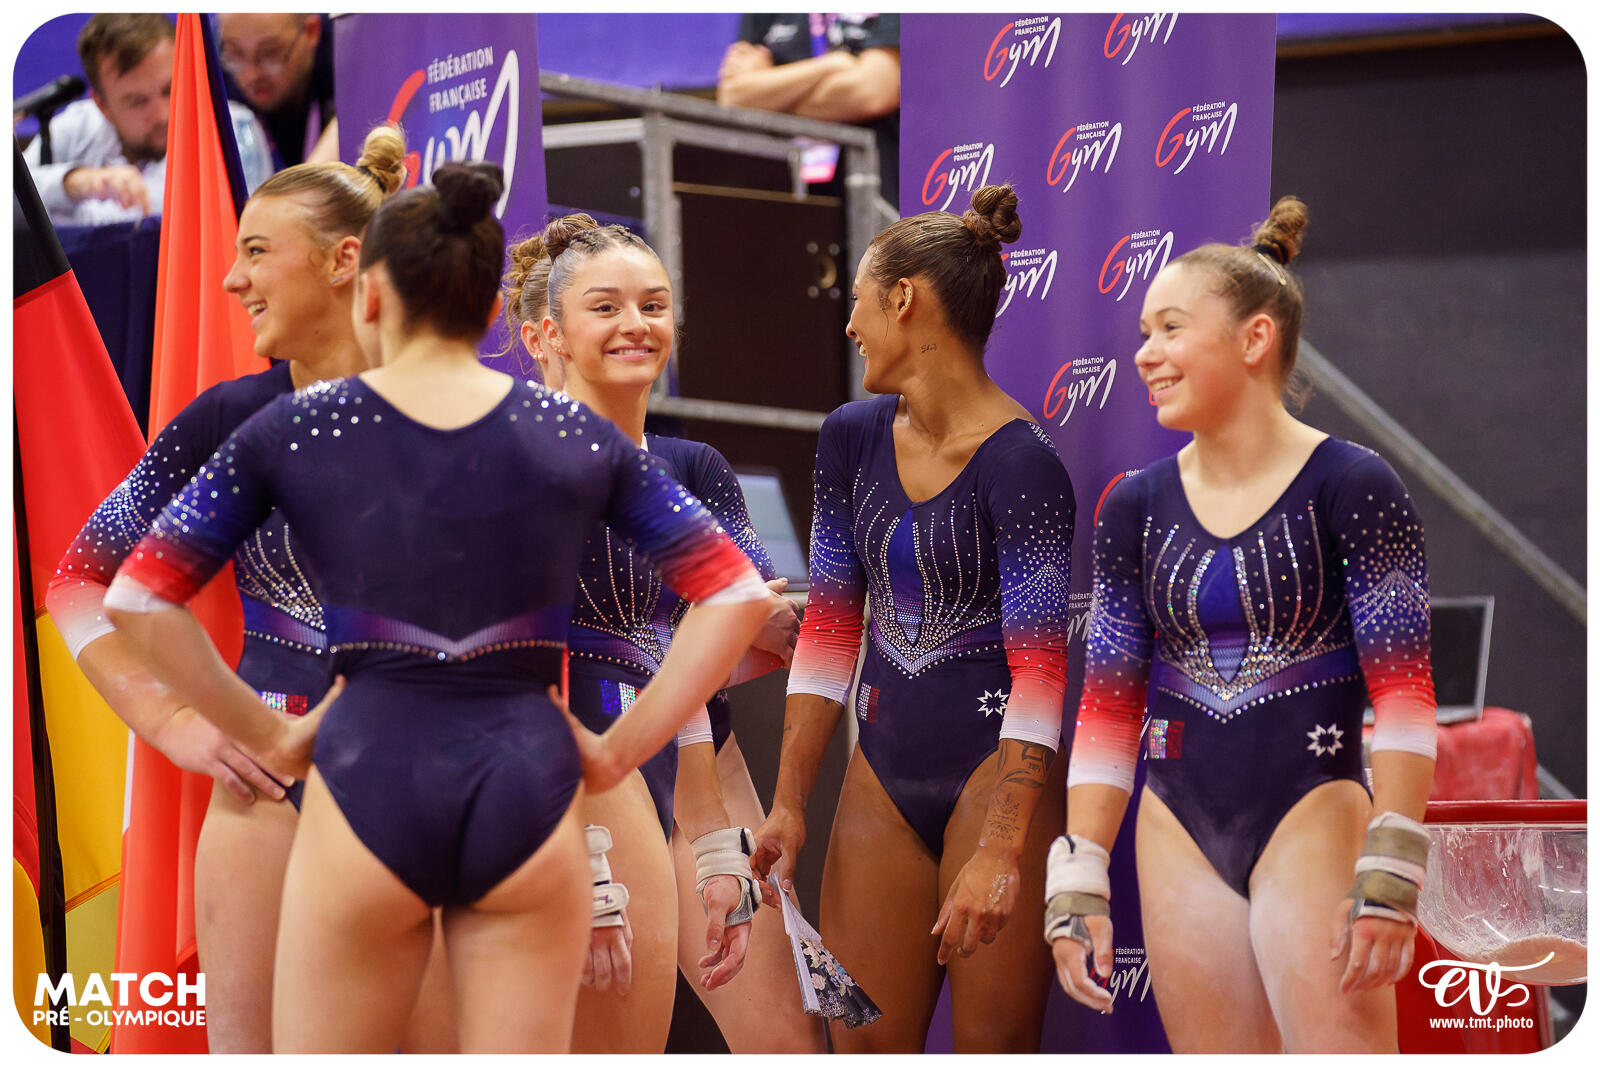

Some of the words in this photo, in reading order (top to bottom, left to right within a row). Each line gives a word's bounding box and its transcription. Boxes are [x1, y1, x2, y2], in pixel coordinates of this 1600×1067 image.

[1014, 16, 1049, 28] FÉDÉRATION
[1014, 25, 1046, 36] FRANÇAISE
[984, 16, 1062, 88] Gym
[428, 46, 494, 85] FÉDÉRATION
[428, 78, 488, 113] FRANÇAISE
[1192, 101, 1226, 113] FÉDÉRATION
[1192, 110, 1223, 121] FRANÇAISE
[1076, 121, 1110, 133] FÉDÉRATION
[1076, 130, 1106, 141] FRANÇAISE
[1155, 102, 1238, 175] Gym
[953, 142, 984, 153] FÉDÉRATION
[953, 151, 981, 162] FRANÇAISE
[1046, 122, 1122, 193] Gym
[922, 143, 994, 212] Gym
[1130, 229, 1161, 240] FÉDÉRATION
[1130, 238, 1157, 249] FRANÇAISE
[1010, 248, 1046, 259] FÉDÉRATION
[1010, 257, 1043, 267] FRANÇAISE
[1098, 231, 1174, 302] Gym
[995, 250, 1058, 318] ym
[1072, 357, 1104, 367] FÉDÉRATION
[1072, 366, 1101, 376] FRANÇAISE
[1043, 358, 1117, 427] Gym
[1115, 947, 1145, 955] FÉDÉRATION
